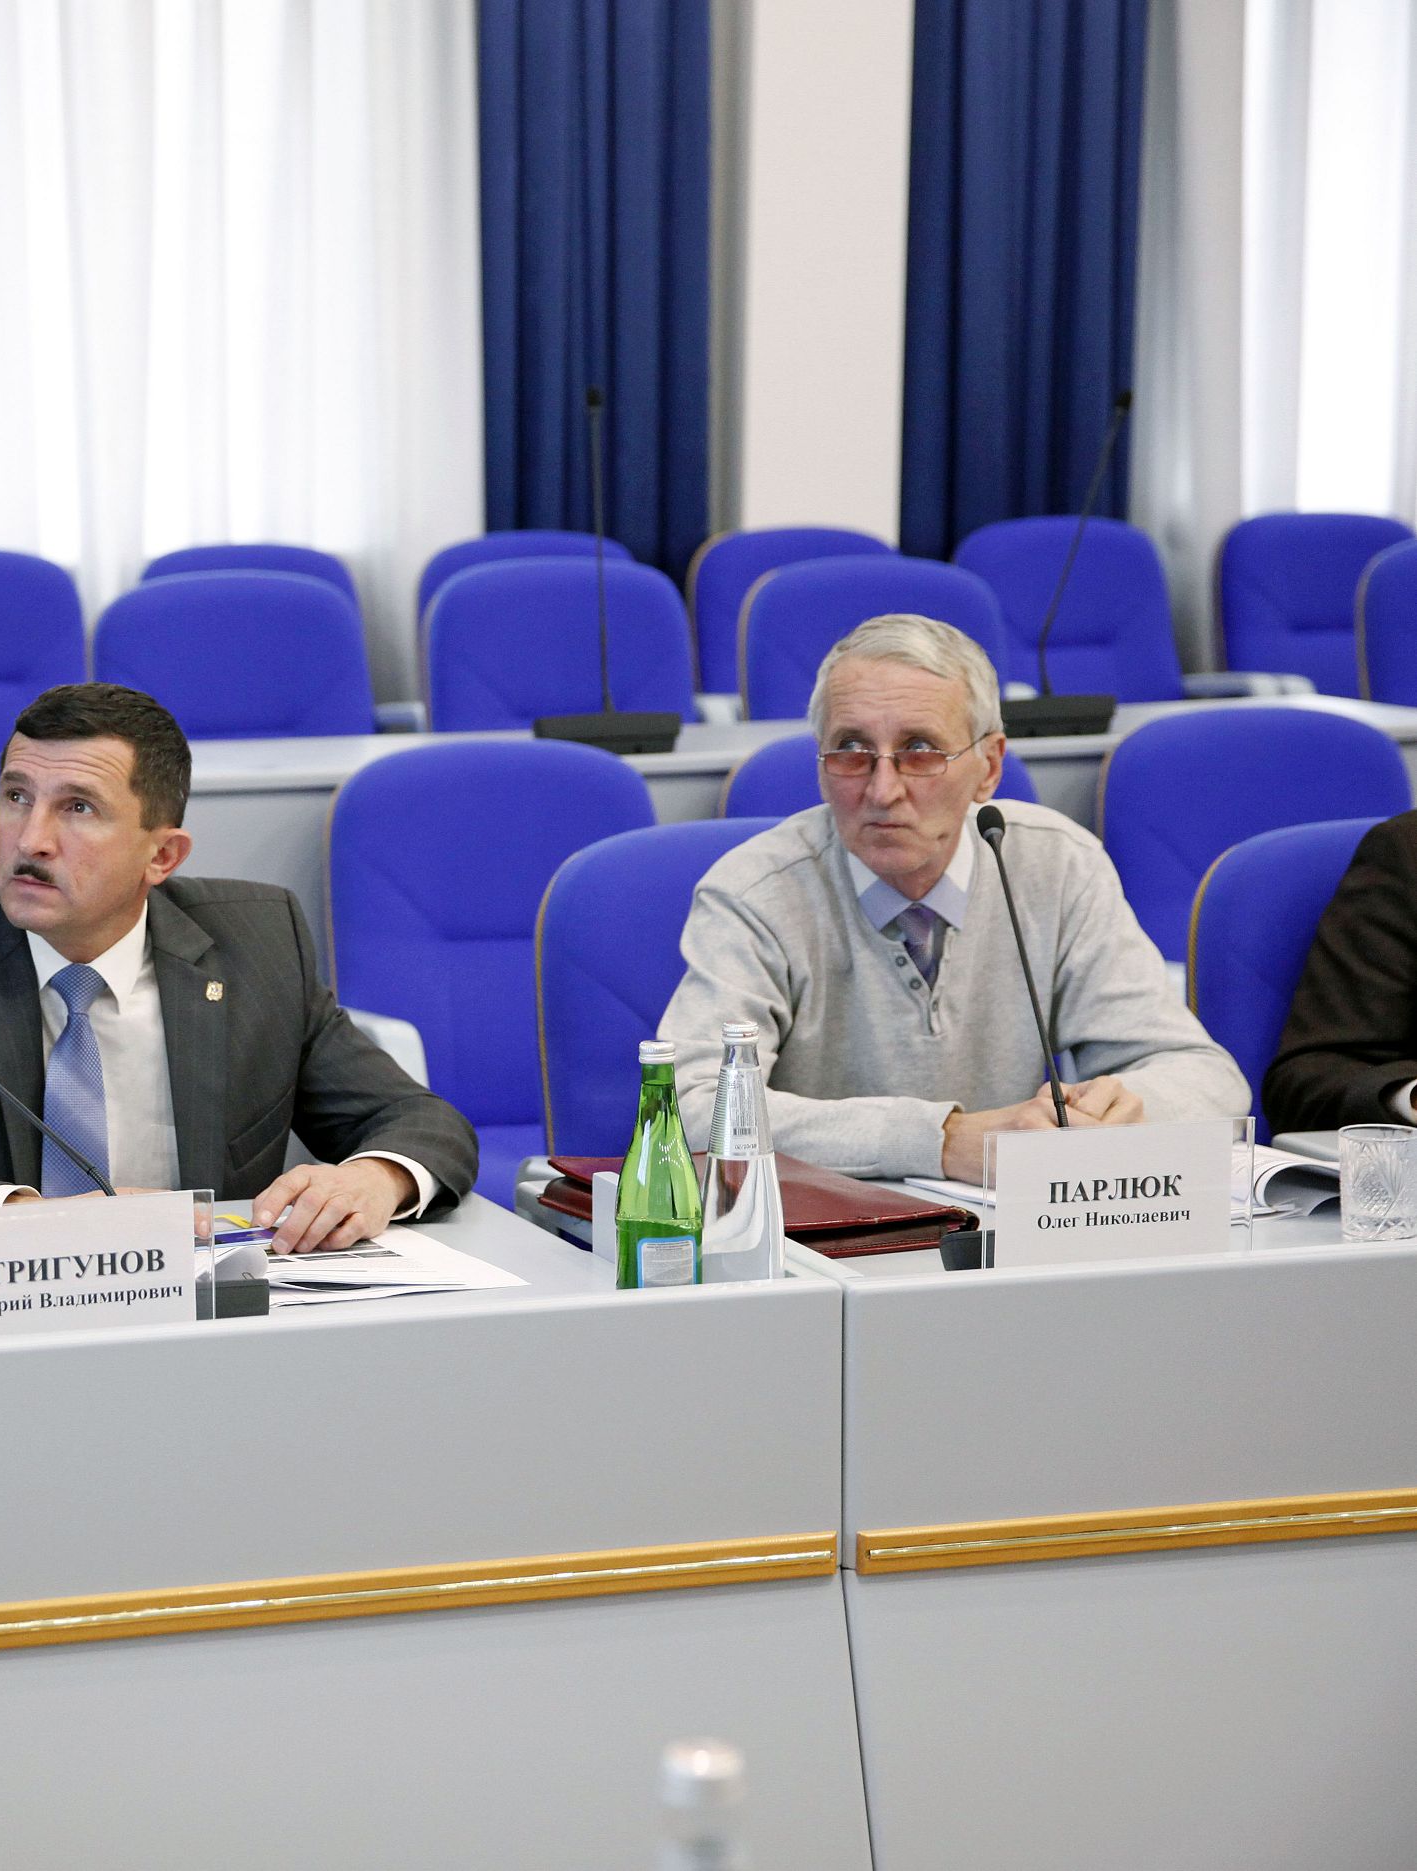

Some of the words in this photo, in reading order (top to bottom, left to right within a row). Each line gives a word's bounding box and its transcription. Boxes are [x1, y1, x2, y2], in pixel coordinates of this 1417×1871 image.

[1048, 1174, 1183, 1204] ПАРЛЮК
[1037, 1213, 1081, 1230] Олег
[1085, 1210, 1191, 1227] Николаевич
[40, 1285, 184, 1310] Владимирович
